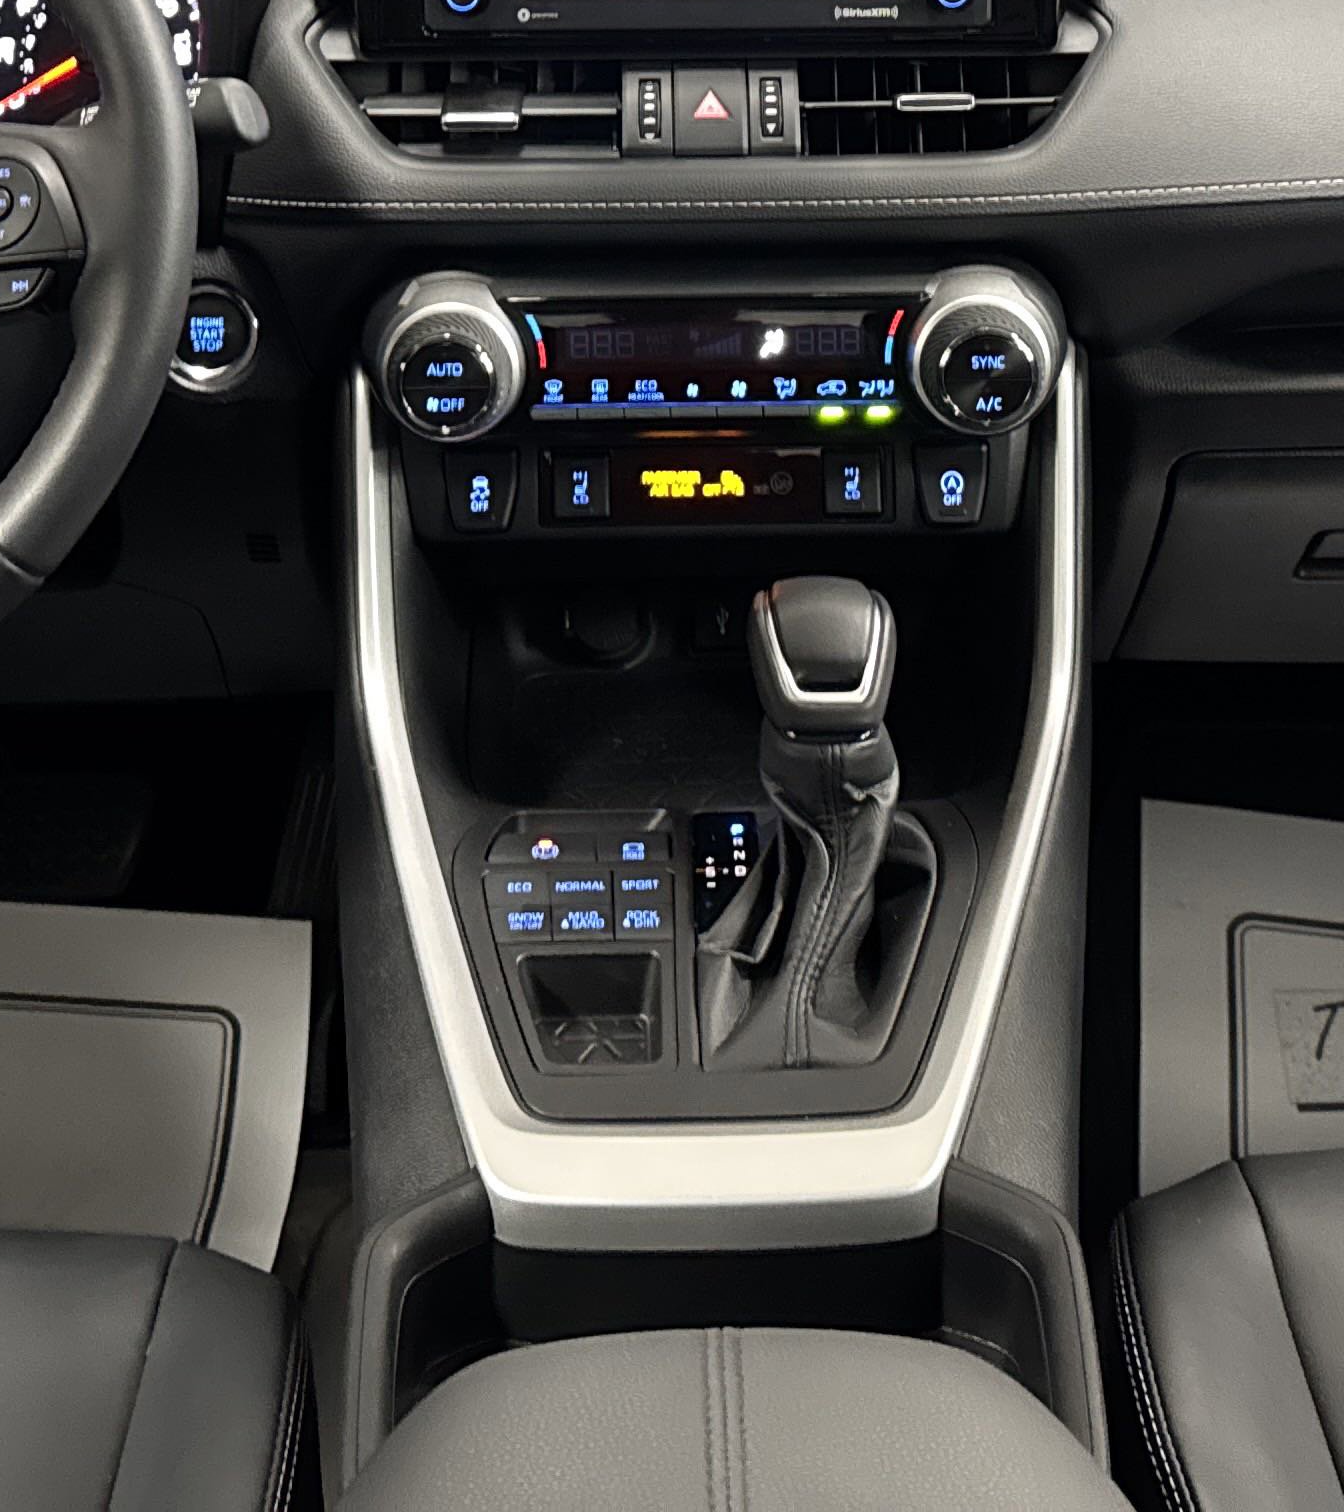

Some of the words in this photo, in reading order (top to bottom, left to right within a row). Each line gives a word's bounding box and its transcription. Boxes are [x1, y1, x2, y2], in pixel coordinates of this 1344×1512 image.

[190, 316, 224, 328] ENGINE
[190, 328, 225, 340] START
[193, 340, 223, 352] STOP
[971, 355, 1006, 370] SYNC
[426, 362, 463, 377] AUTO
[440, 398, 465, 412] OFF
[975, 395, 1003, 412] A/C
[470, 500, 489, 513] OFF
[943, 493, 963, 507] OFF
[733, 849, 746, 861] N
[507, 881, 532, 893] ECO
[555, 880, 606, 893] NORMAL
[621, 878, 660, 891] SPORT
